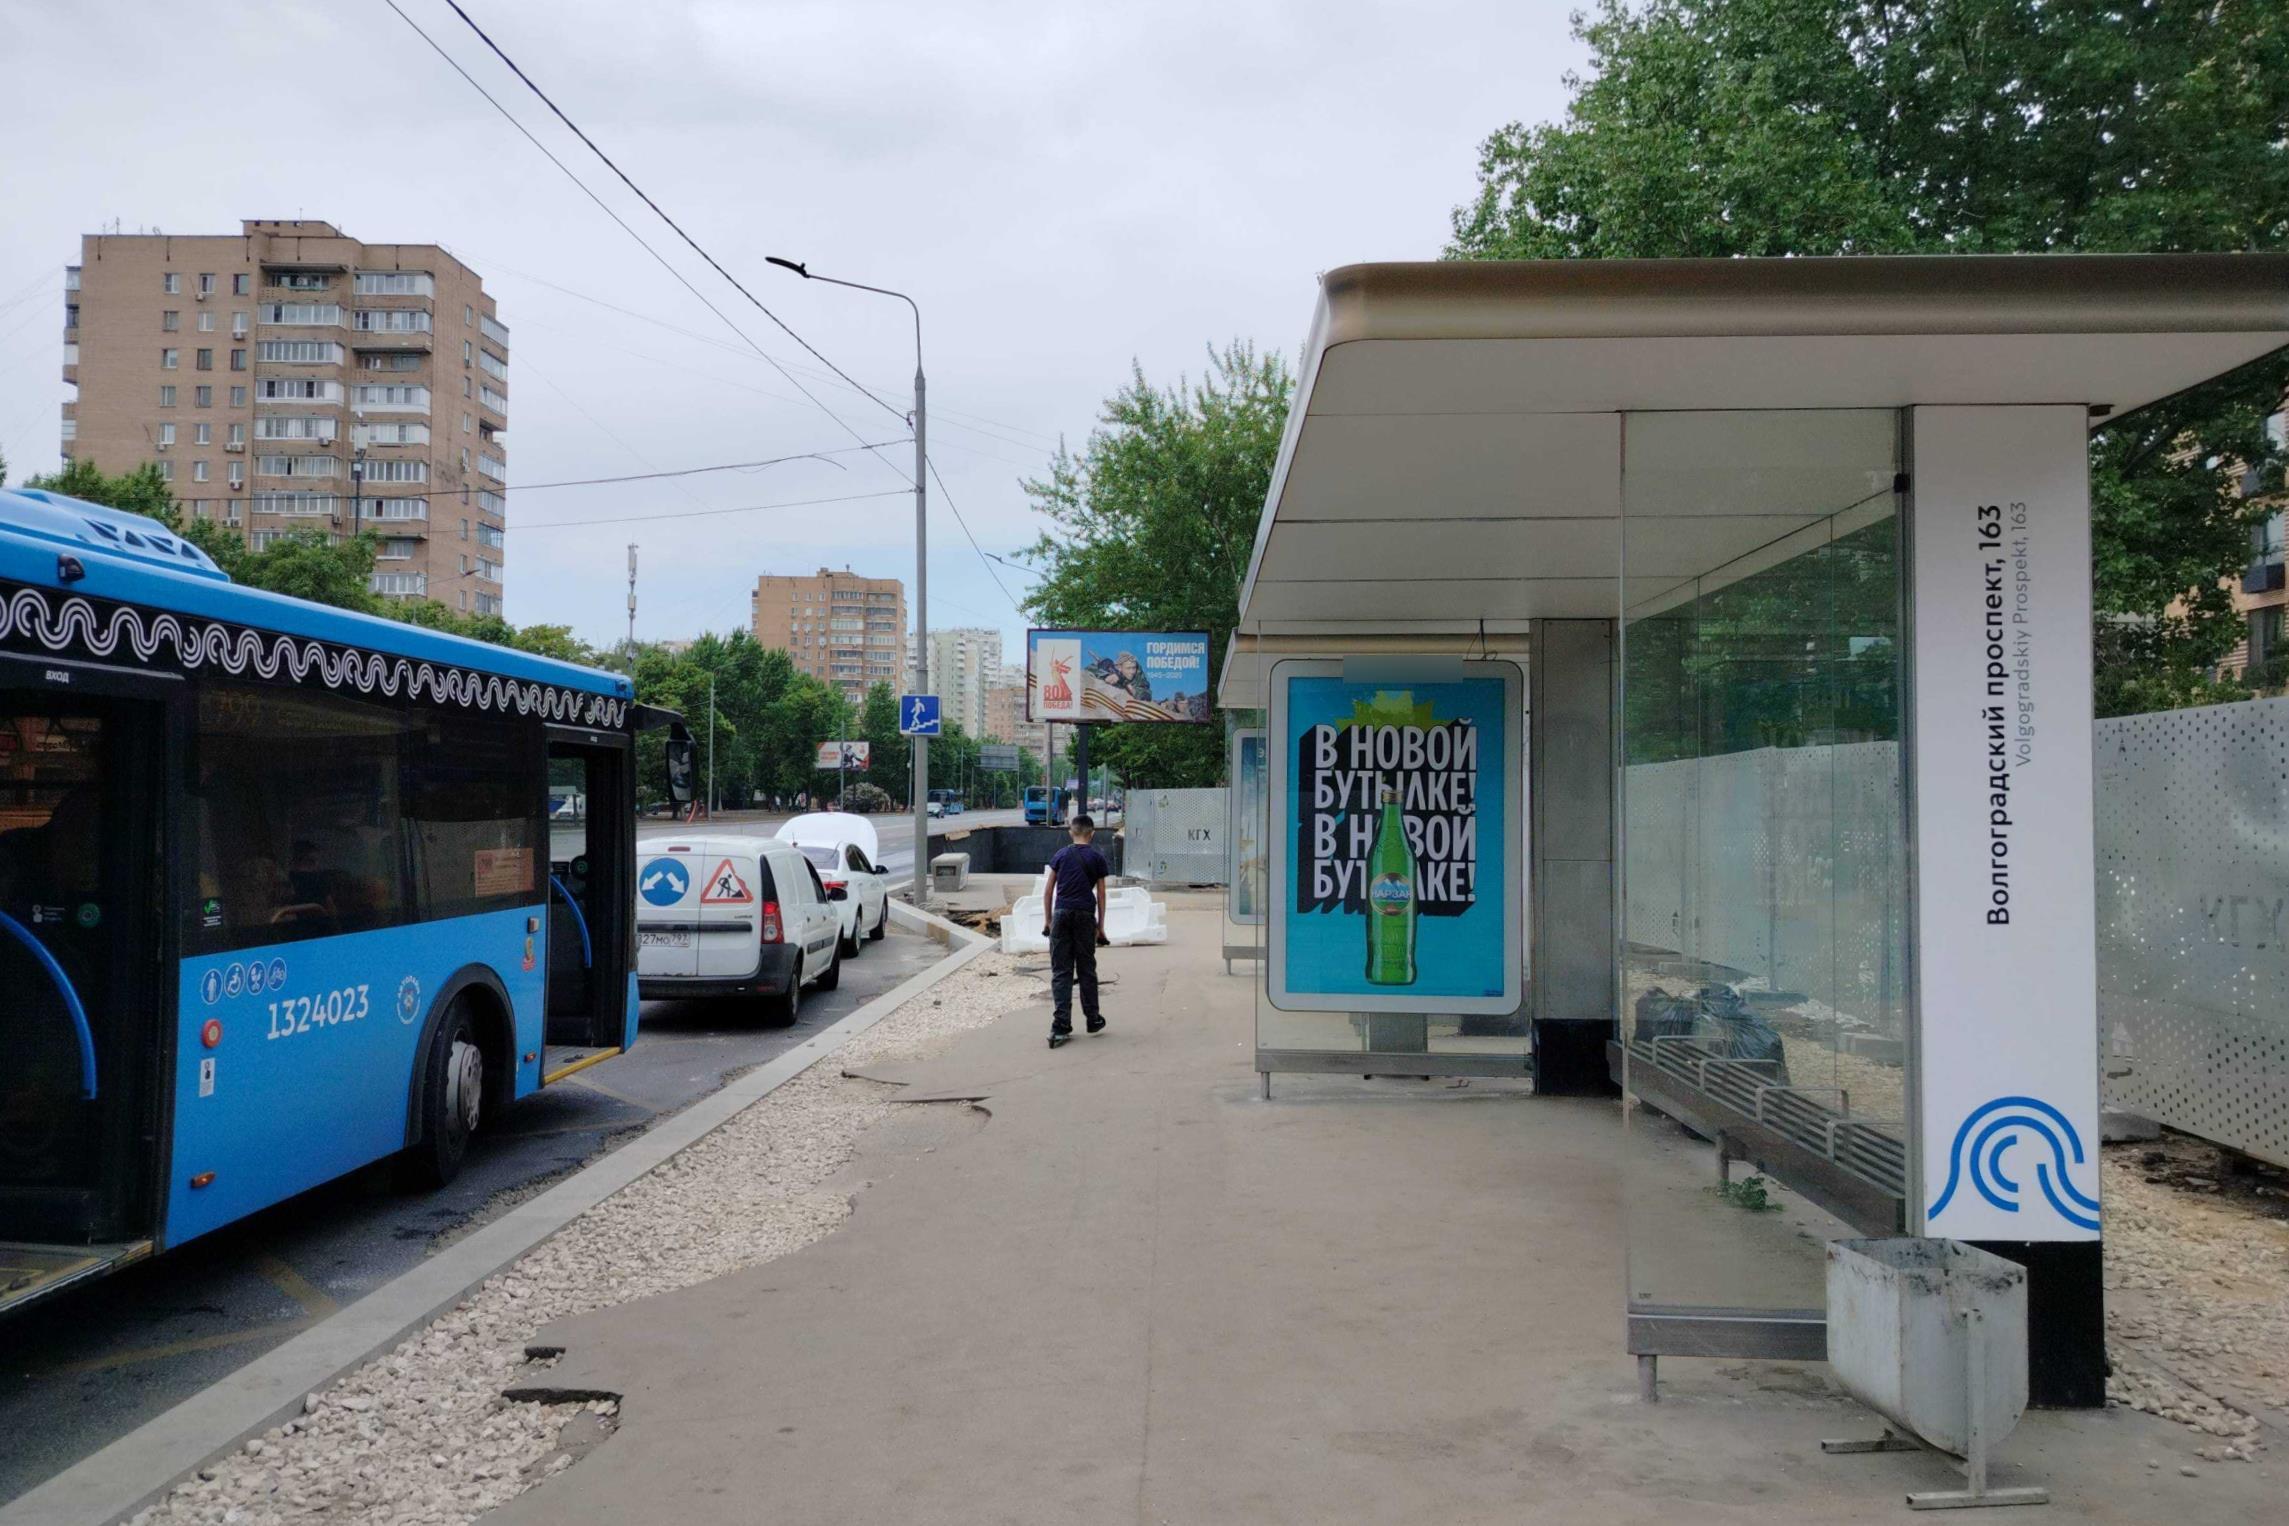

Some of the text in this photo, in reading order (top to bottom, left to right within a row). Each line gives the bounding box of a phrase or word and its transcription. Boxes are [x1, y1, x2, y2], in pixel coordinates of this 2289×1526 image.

[1146, 642, 1205, 656] ГОРДИМСЯ
[2009, 501, 2035, 768] Volgogradskiy Prospekt, 163
[45, 670, 69, 684] ВХОД
[1146, 655, 1201, 670] ПОБЕДОЙ!
[1977, 504, 2013, 925] Волгоградский проспект, 163
[1315, 724, 1339, 769] В
[1350, 717, 1478, 771] НОВОЙ
[1314, 770, 1478, 811] БУТЫЛКЕ!
[1314, 805, 1477, 861] В НВОЙ
[267, 984, 370, 1041] 1324023
